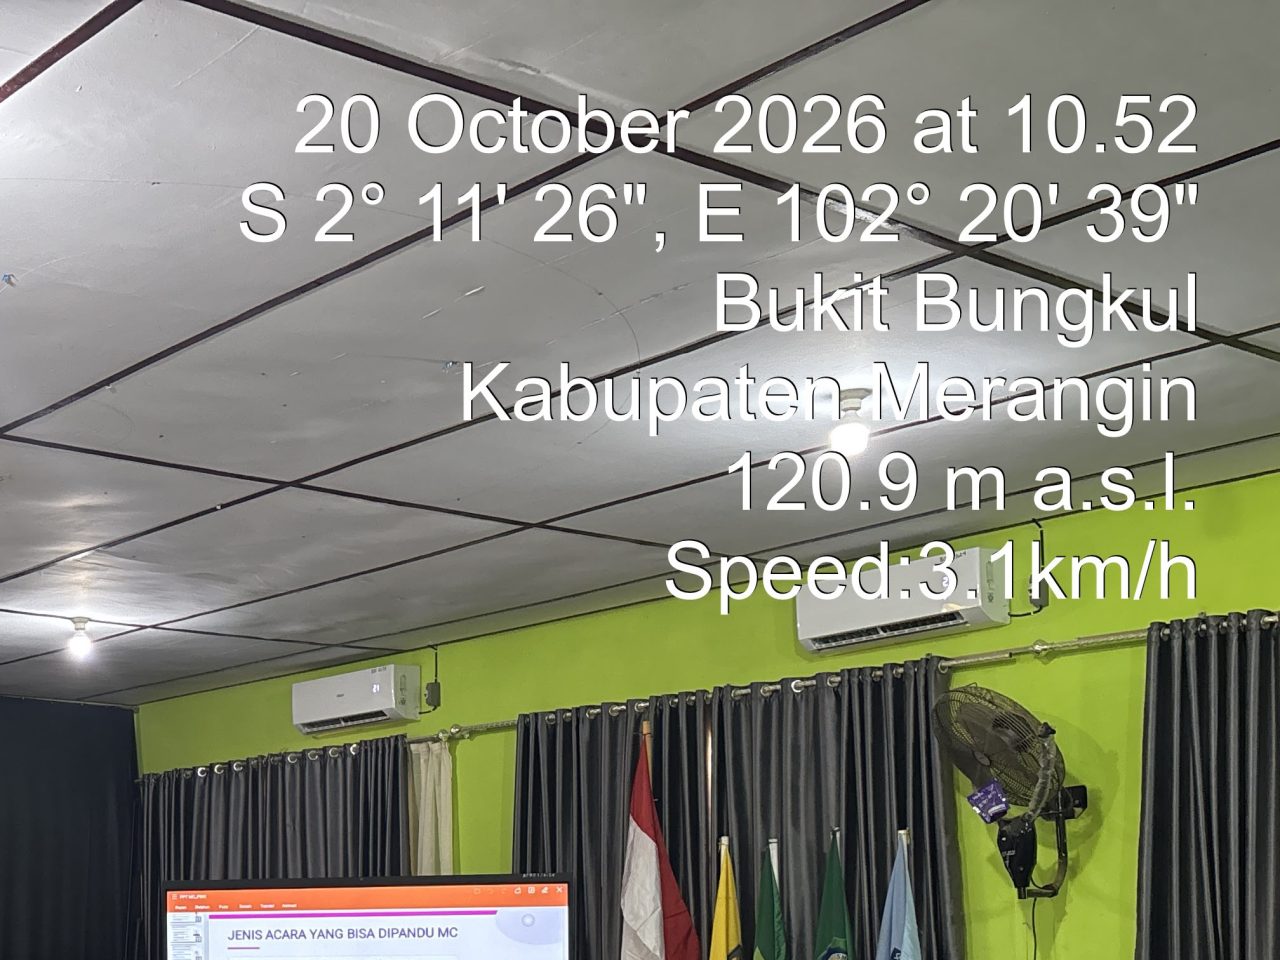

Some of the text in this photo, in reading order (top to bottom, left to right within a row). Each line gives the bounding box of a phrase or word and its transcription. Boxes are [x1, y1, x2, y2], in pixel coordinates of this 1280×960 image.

[227, 926, 459, 941] JENIS ACARA YANG BISA DIPANDU MC
